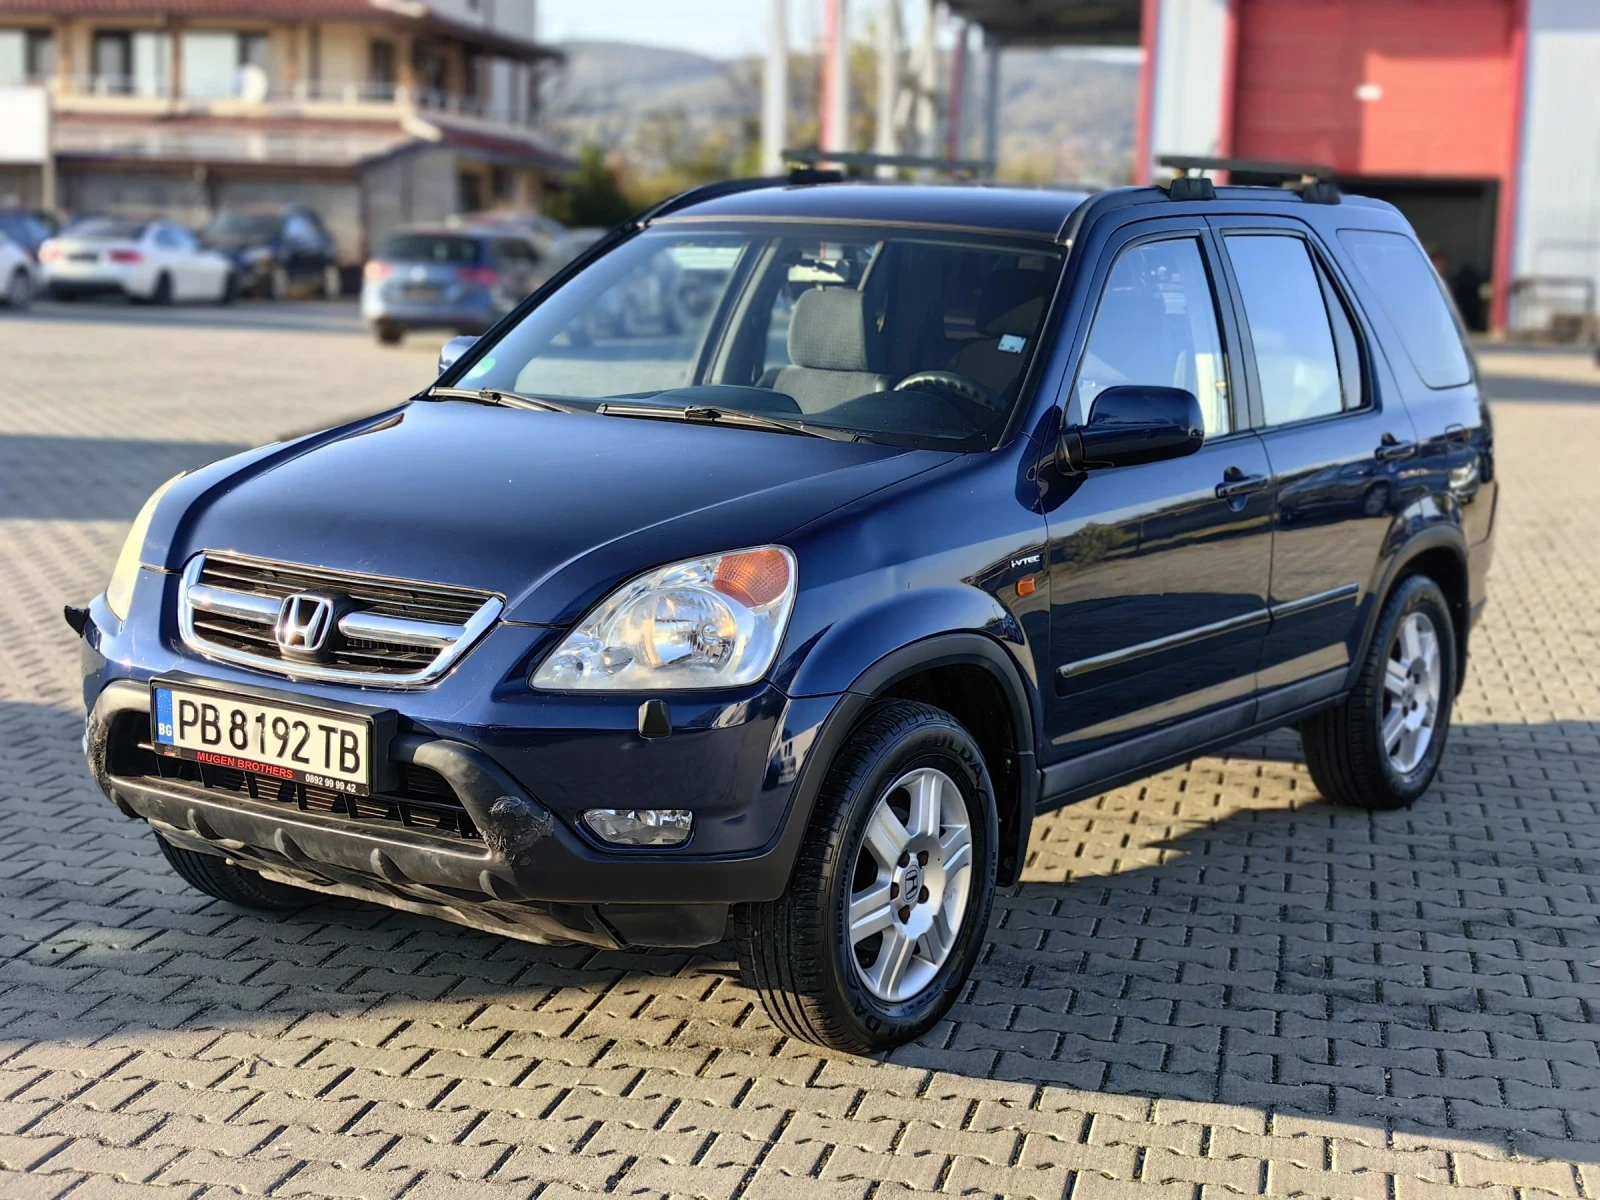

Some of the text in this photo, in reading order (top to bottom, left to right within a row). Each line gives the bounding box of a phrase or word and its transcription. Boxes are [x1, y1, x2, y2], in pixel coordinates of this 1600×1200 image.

[158, 722, 173, 737] BG
[229, 709, 312, 764] 8192
[196, 751, 235, 767] MUGEN
[237, 759, 294, 779] BROTHERS
[305, 773, 356, 793] 0892 99 99 42
